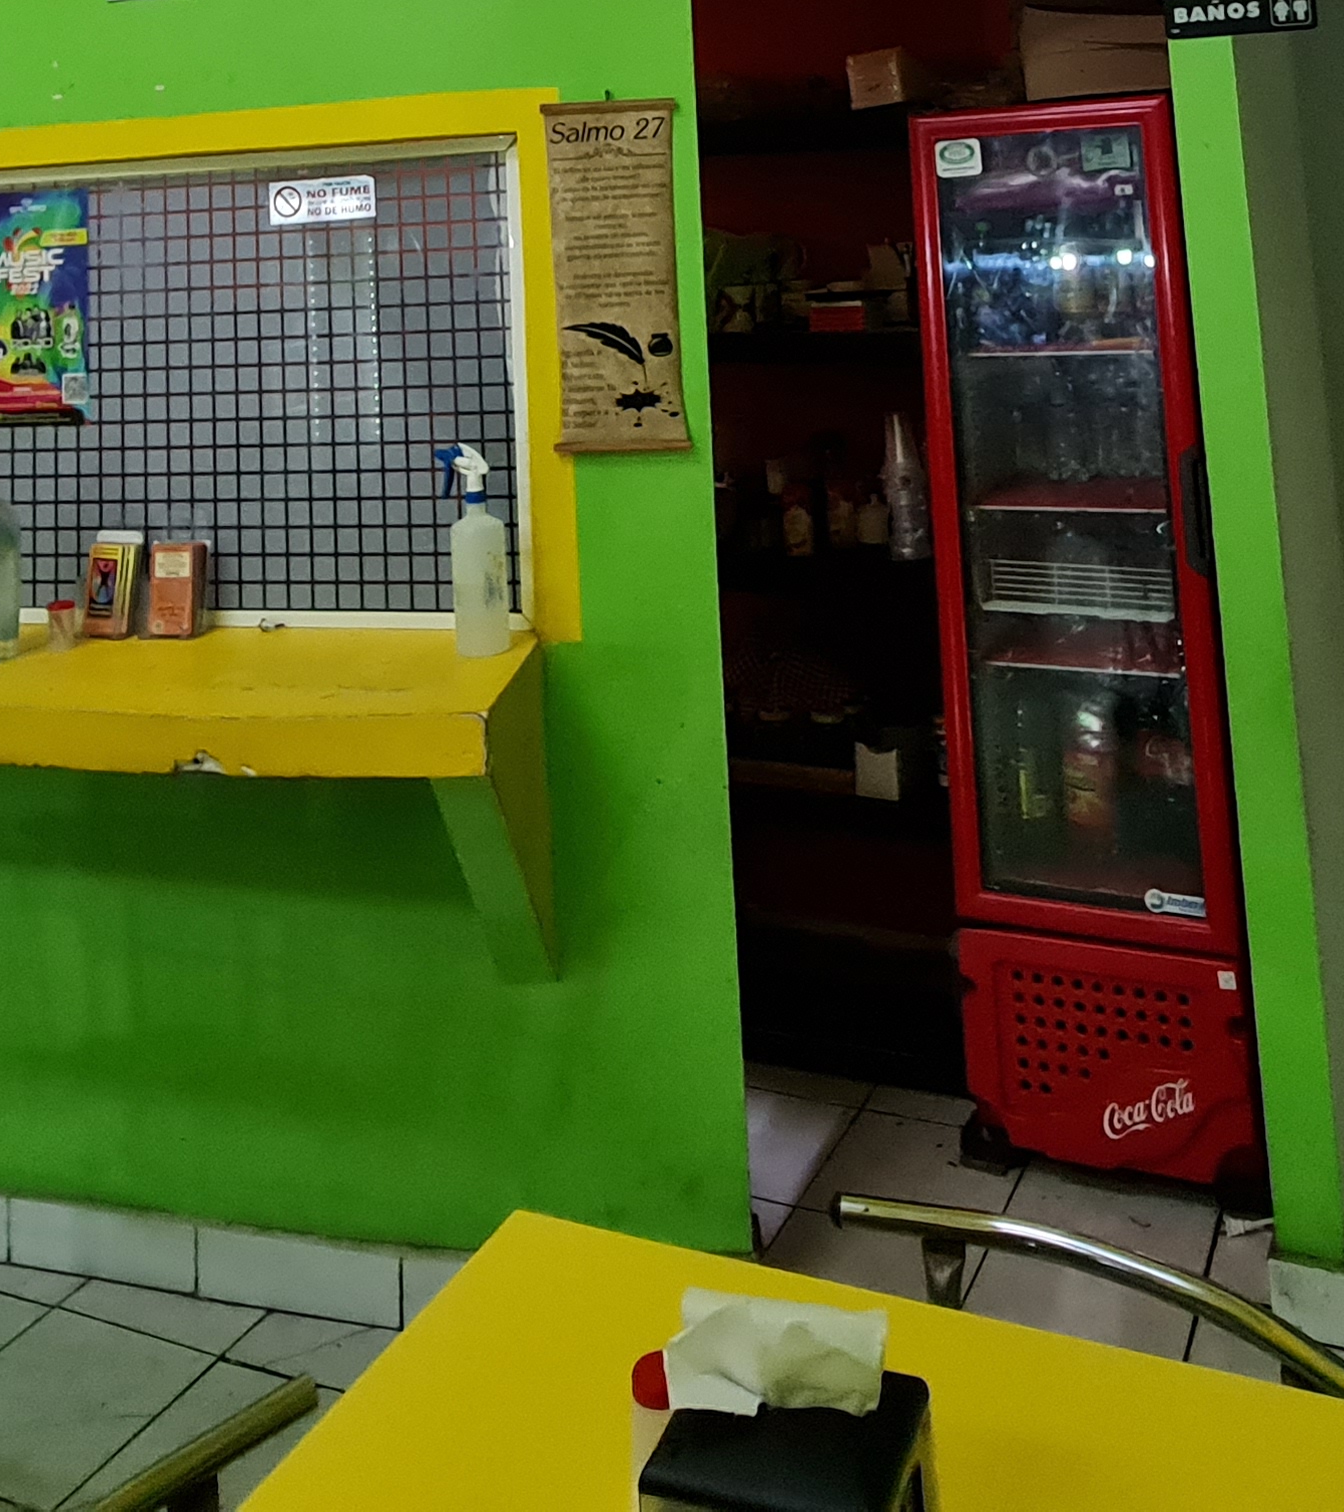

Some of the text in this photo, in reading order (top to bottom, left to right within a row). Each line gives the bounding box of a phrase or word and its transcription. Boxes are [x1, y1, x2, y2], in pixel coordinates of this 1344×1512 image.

[1173, 0, 1261, 24] BAÑOS
[550, 117, 666, 144] Salmo 27
[306, 185, 371, 198] NO FUME
[341, 203, 372, 214] HUMO
[1103, 1078, 1195, 1140] Coca-Cola
